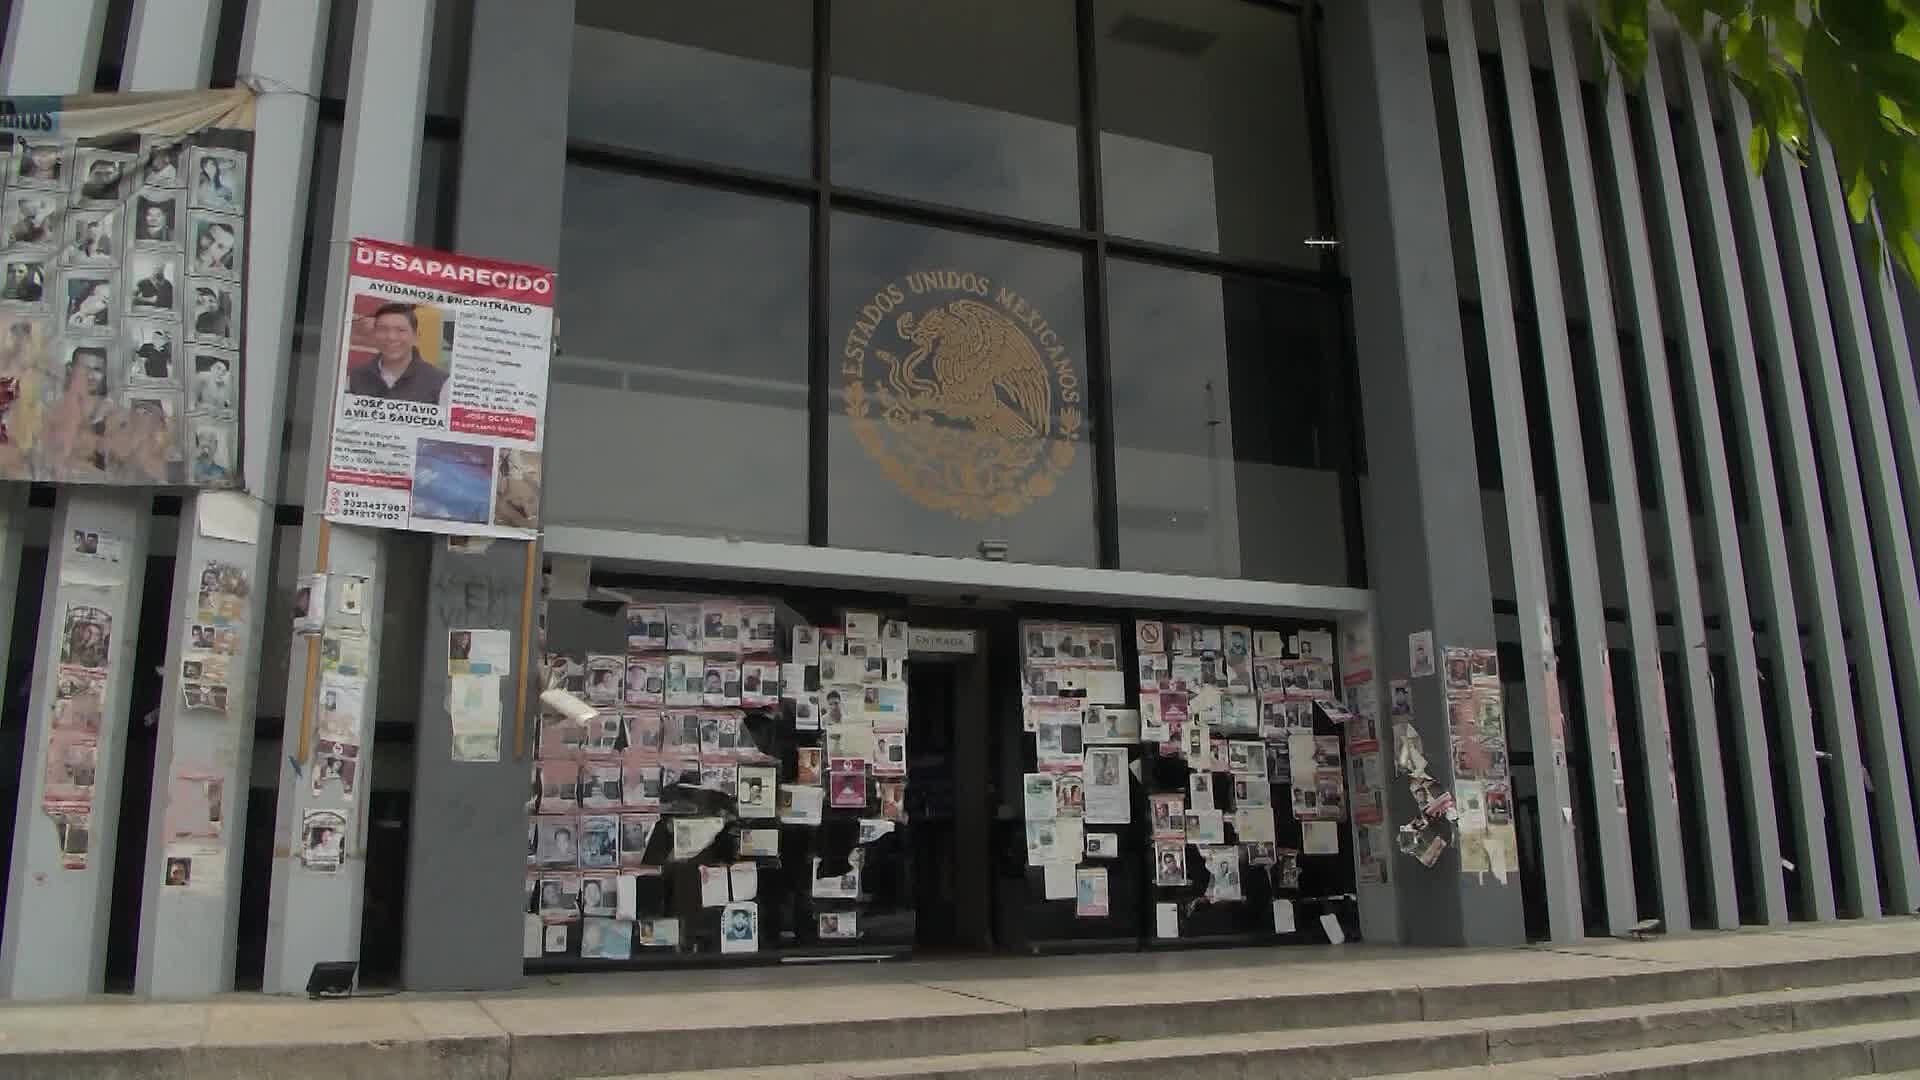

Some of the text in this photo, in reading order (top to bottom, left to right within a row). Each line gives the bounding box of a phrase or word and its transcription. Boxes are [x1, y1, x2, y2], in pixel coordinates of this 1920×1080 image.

[355, 246, 550, 294] DESAPARECIDO
[436, 295, 444, 303] A
[447, 296, 533, 316] ENCONTRARLO
[843, 271, 1080, 404] ESTADOS UNIDOS MEXICANOS
[386, 402, 439, 416] OCTAVIO
[389, 413, 445, 428] SAUCEDA
